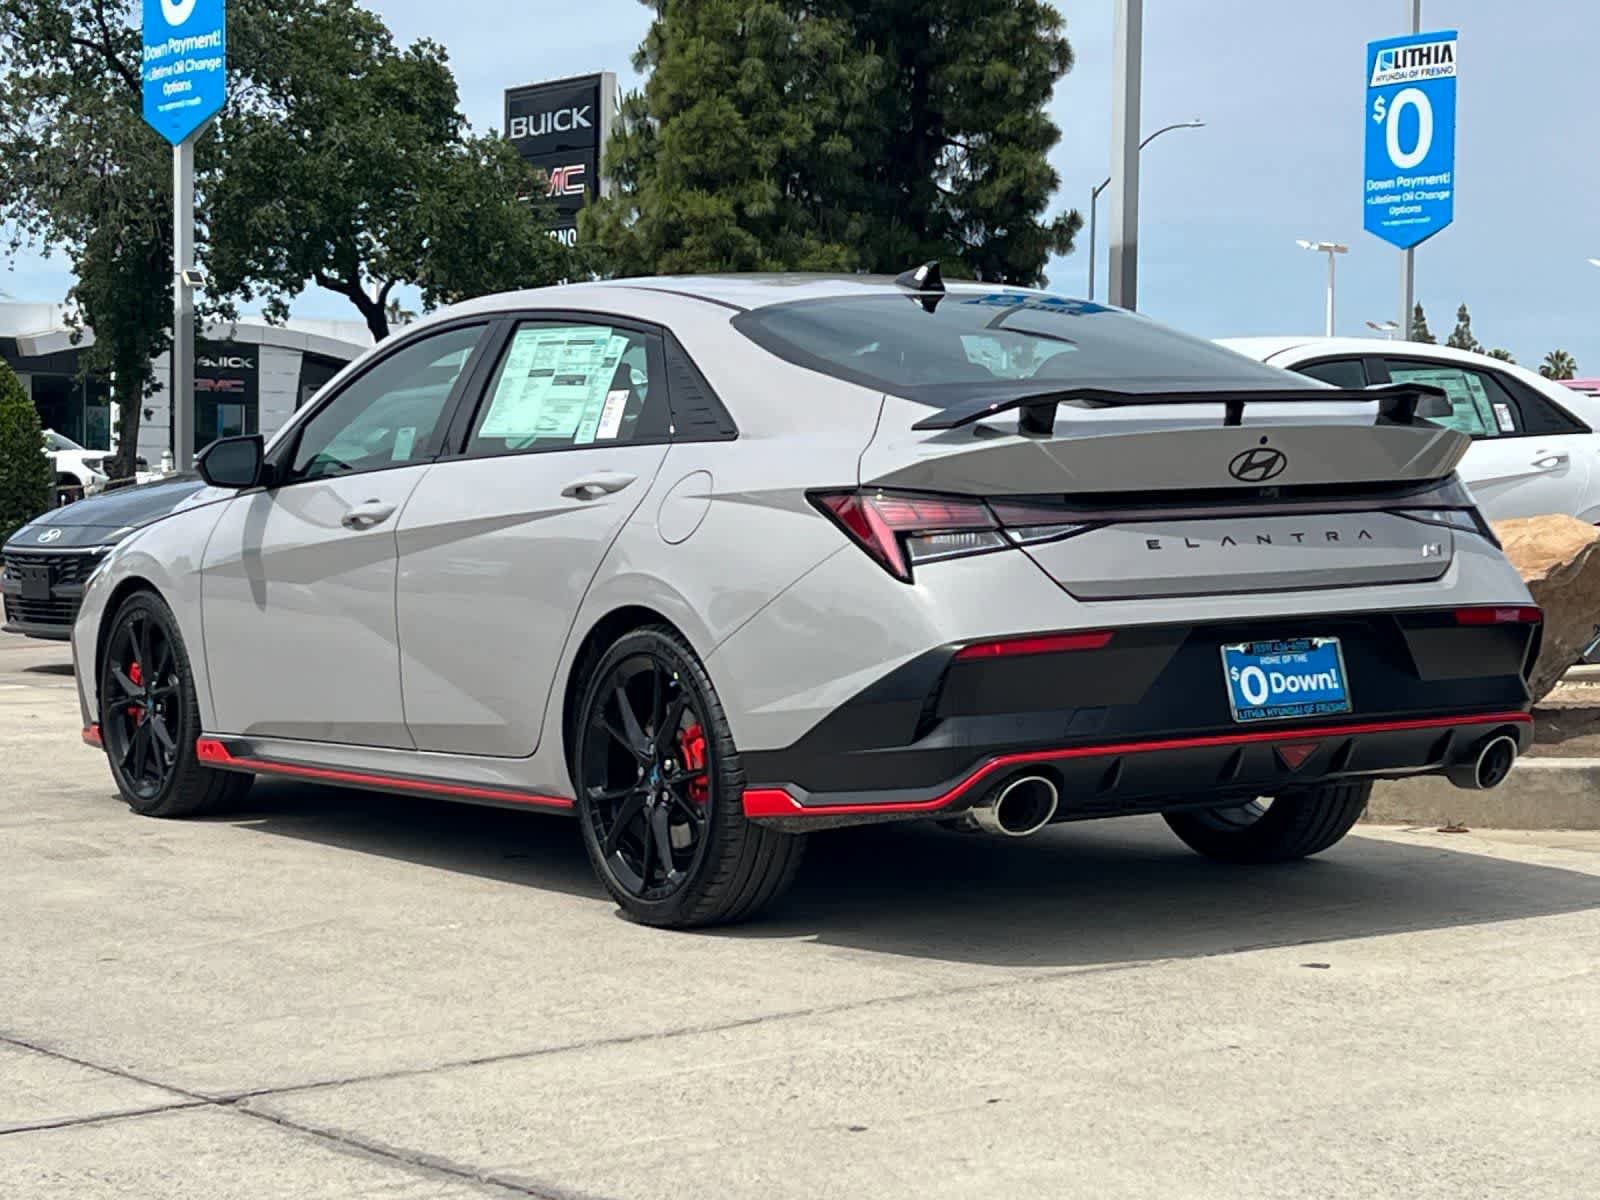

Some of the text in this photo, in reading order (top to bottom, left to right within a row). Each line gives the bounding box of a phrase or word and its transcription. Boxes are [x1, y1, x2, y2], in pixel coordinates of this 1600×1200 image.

[144, 30, 221, 60] Down Payment!
[185, 57, 222, 72] Change
[1394, 44, 1453, 69] LITHIA
[1375, 66, 1454, 82] HYUNDAI OF FRESNO
[510, 105, 592, 139] BUICK
[1366, 172, 1450, 192] Down Payment!
[1402, 191, 1414, 202] Oil
[1415, 190, 1450, 200] Change
[1389, 205, 1422, 216] Options
[198, 356, 254, 368] BUICK
[194, 379, 245, 392] GMC
[1146, 530, 1372, 550] ELANTRA
[1260, 653, 1308, 665] HOME OF THE
[1270, 668, 1339, 693] Down!
